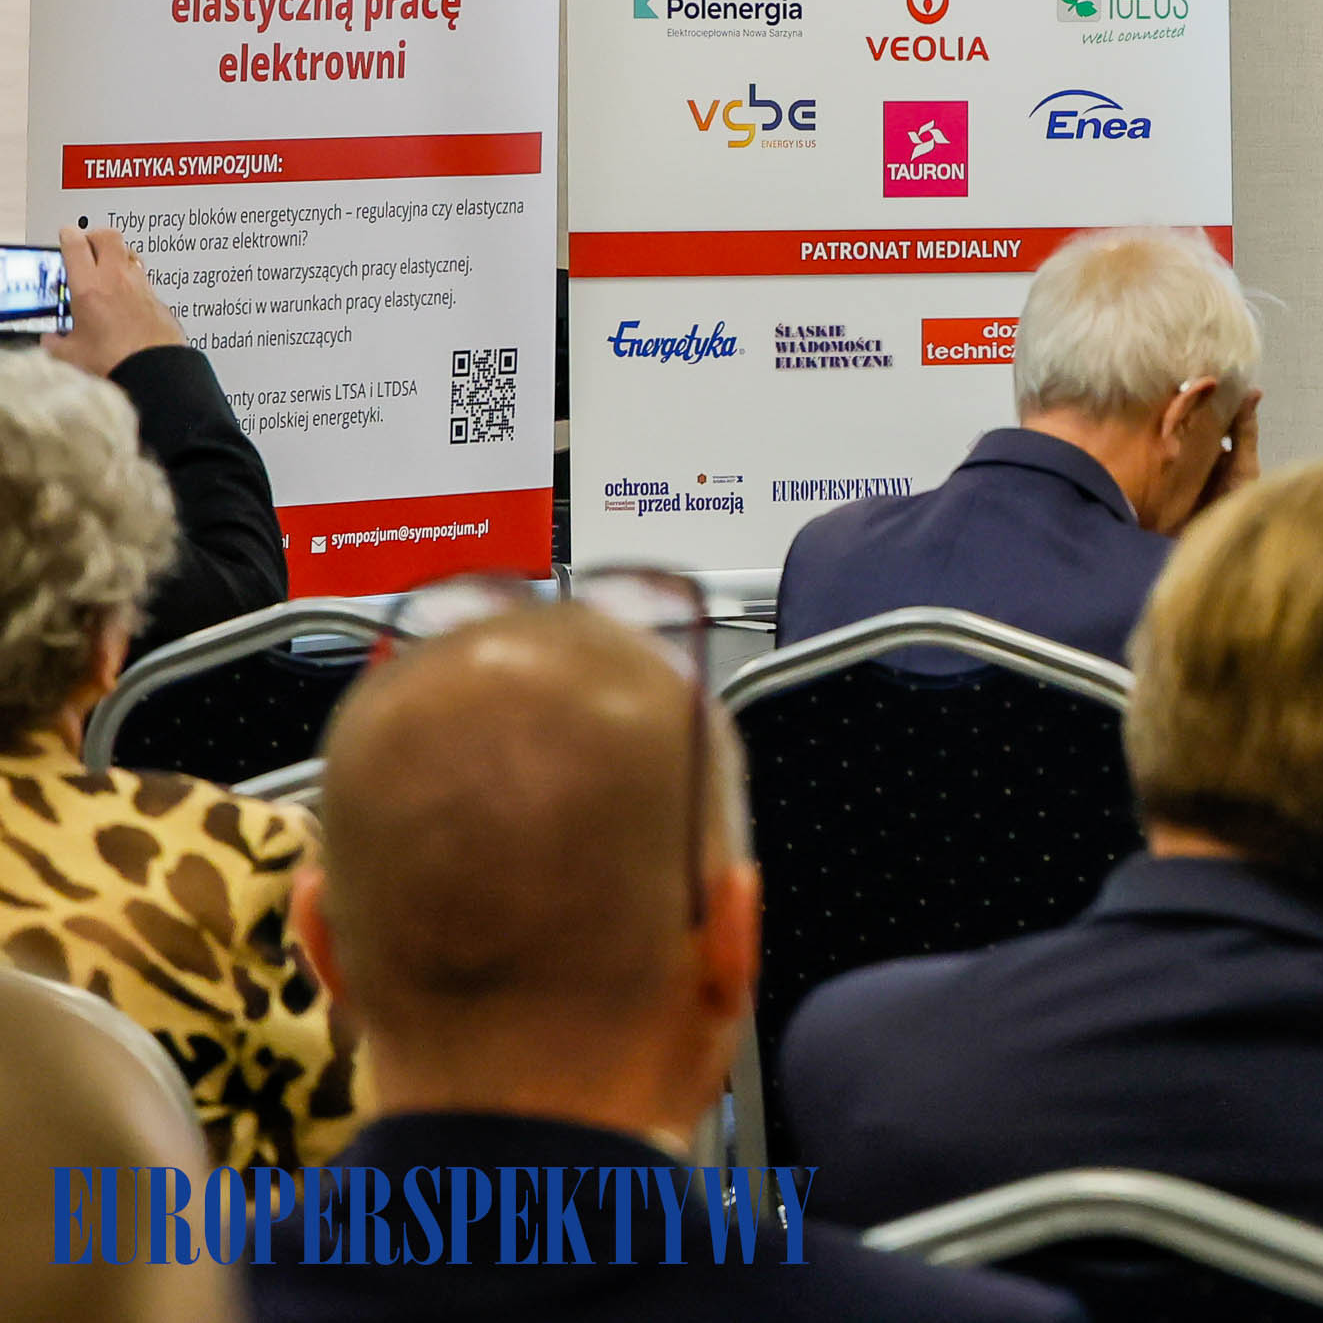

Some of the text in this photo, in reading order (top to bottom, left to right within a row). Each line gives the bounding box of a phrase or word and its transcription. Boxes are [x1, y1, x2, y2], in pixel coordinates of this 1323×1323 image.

[667, 28, 740, 38] Elektrociepłownia
[866, 36, 989, 61] VEOLIA
[219, 40, 406, 82] elektrowni
[1046, 111, 1151, 139] Enea
[85, 154, 282, 178] TEMATYKA SYMPOZJUM:
[887, 164, 965, 180] TAURON
[149, 199, 523, 232] pracy bloków energetycznych regulacyjna czy elastyczna
[149, 230, 308, 252] bloków oraz elektrowni?
[802, 240, 1021, 260] PATRONAT MEDIALNY
[193, 256, 472, 288] zagrożeń towarzyszących pracy elastycznej.
[193, 289, 456, 317] trwałości warunkach pracy elastycznej.
[212, 326, 351, 349] badań nieniszczących
[607, 321, 737, 364] Energetyka
[776, 340, 880, 353] WIADOMOŚCI
[776, 356, 892, 368] ELEKTRYCZNE
[258, 381, 417, 404] oraz serwis LTSA LTDSA
[260, 407, 383, 434] polskiej energetyki.
[605, 478, 669, 496] ochrona
[638, 491, 680, 516] przed
[686, 492, 743, 514] korozją
[331, 519, 489, 547] sympozjum@sympozjum.pl
